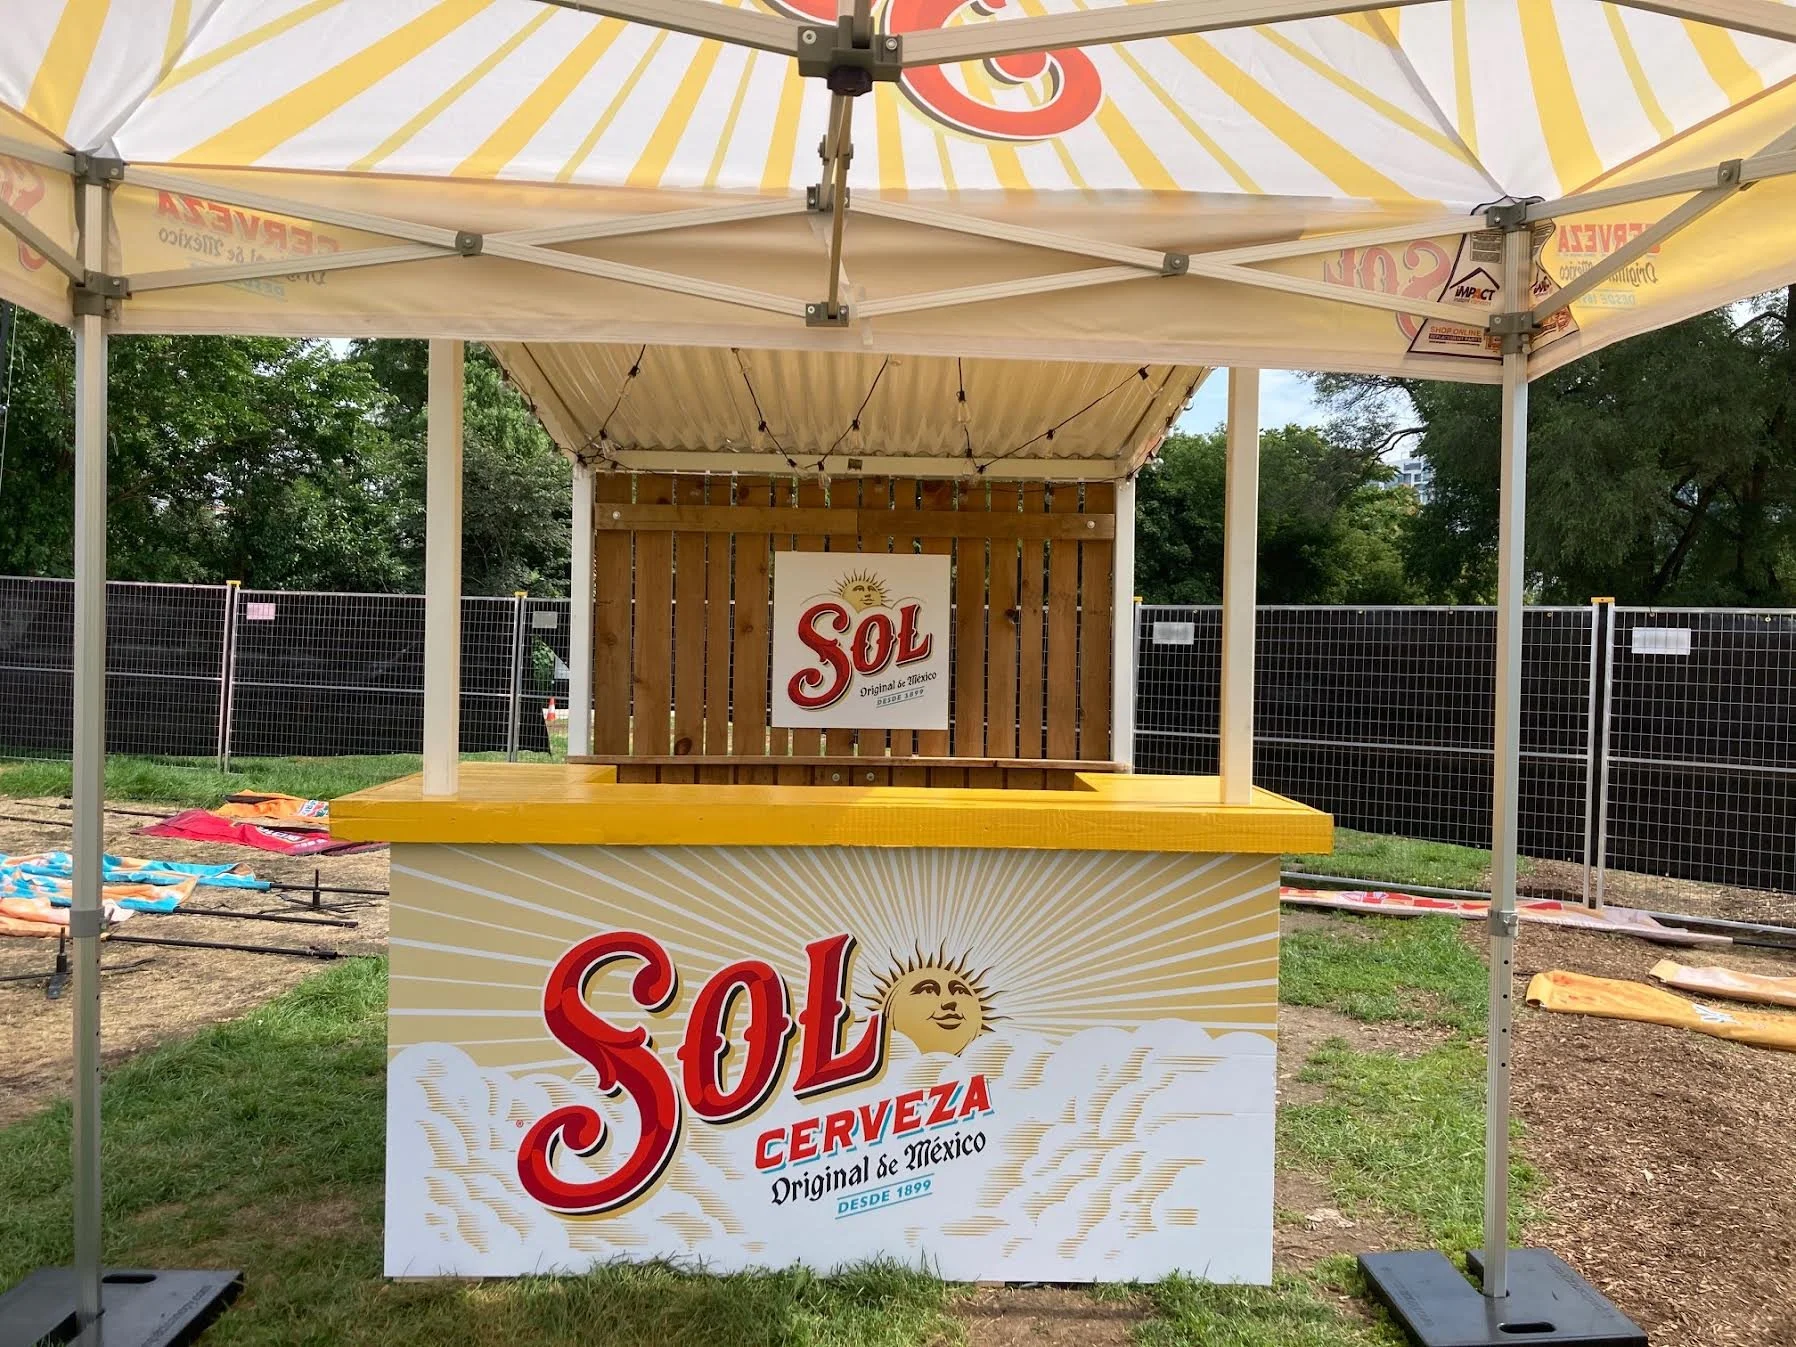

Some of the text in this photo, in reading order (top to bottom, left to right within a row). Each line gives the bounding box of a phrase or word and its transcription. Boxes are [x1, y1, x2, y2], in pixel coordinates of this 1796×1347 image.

[1430, 326, 1482, 337] SHOP ONLINE
[787, 602, 934, 711] SOL
[860, 671, 937, 697] Original de México
[876, 688, 924, 706] DESDE 1899
[516, 930, 886, 1217] SOL
[754, 1074, 995, 1174] CERVEZA
[771, 1130, 986, 1206] Original de México
[837, 1178, 932, 1214] DESDE 1899
